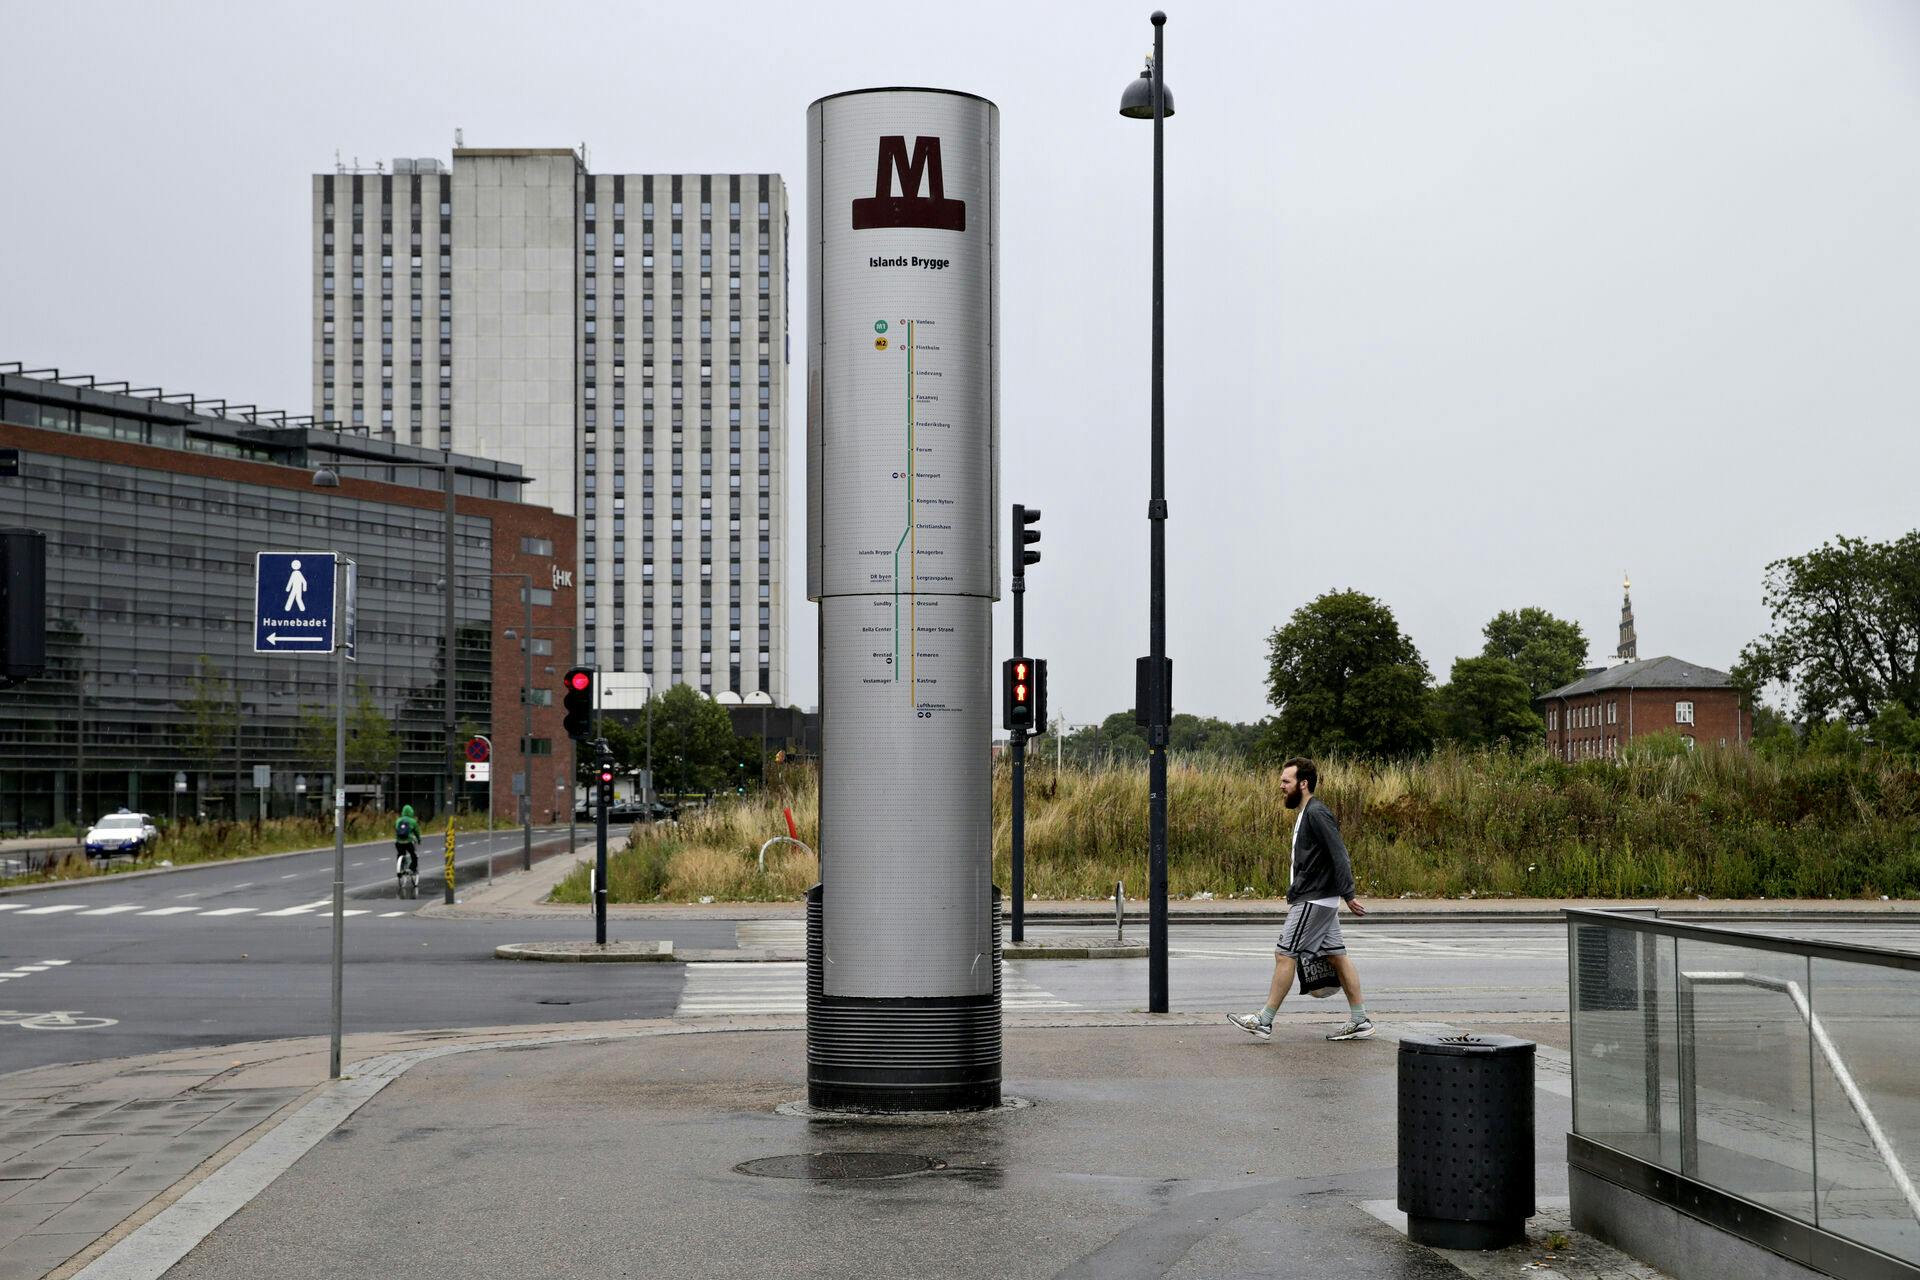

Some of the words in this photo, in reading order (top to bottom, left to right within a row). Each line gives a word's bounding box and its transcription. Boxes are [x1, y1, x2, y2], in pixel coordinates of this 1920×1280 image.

[869, 256, 908, 268] Islands
[911, 256, 950, 270] Brygge
[916, 421, 951, 429] Frederiksberg
[556, 569, 572, 587] HK
[262, 617, 328, 627] Havnebadet
